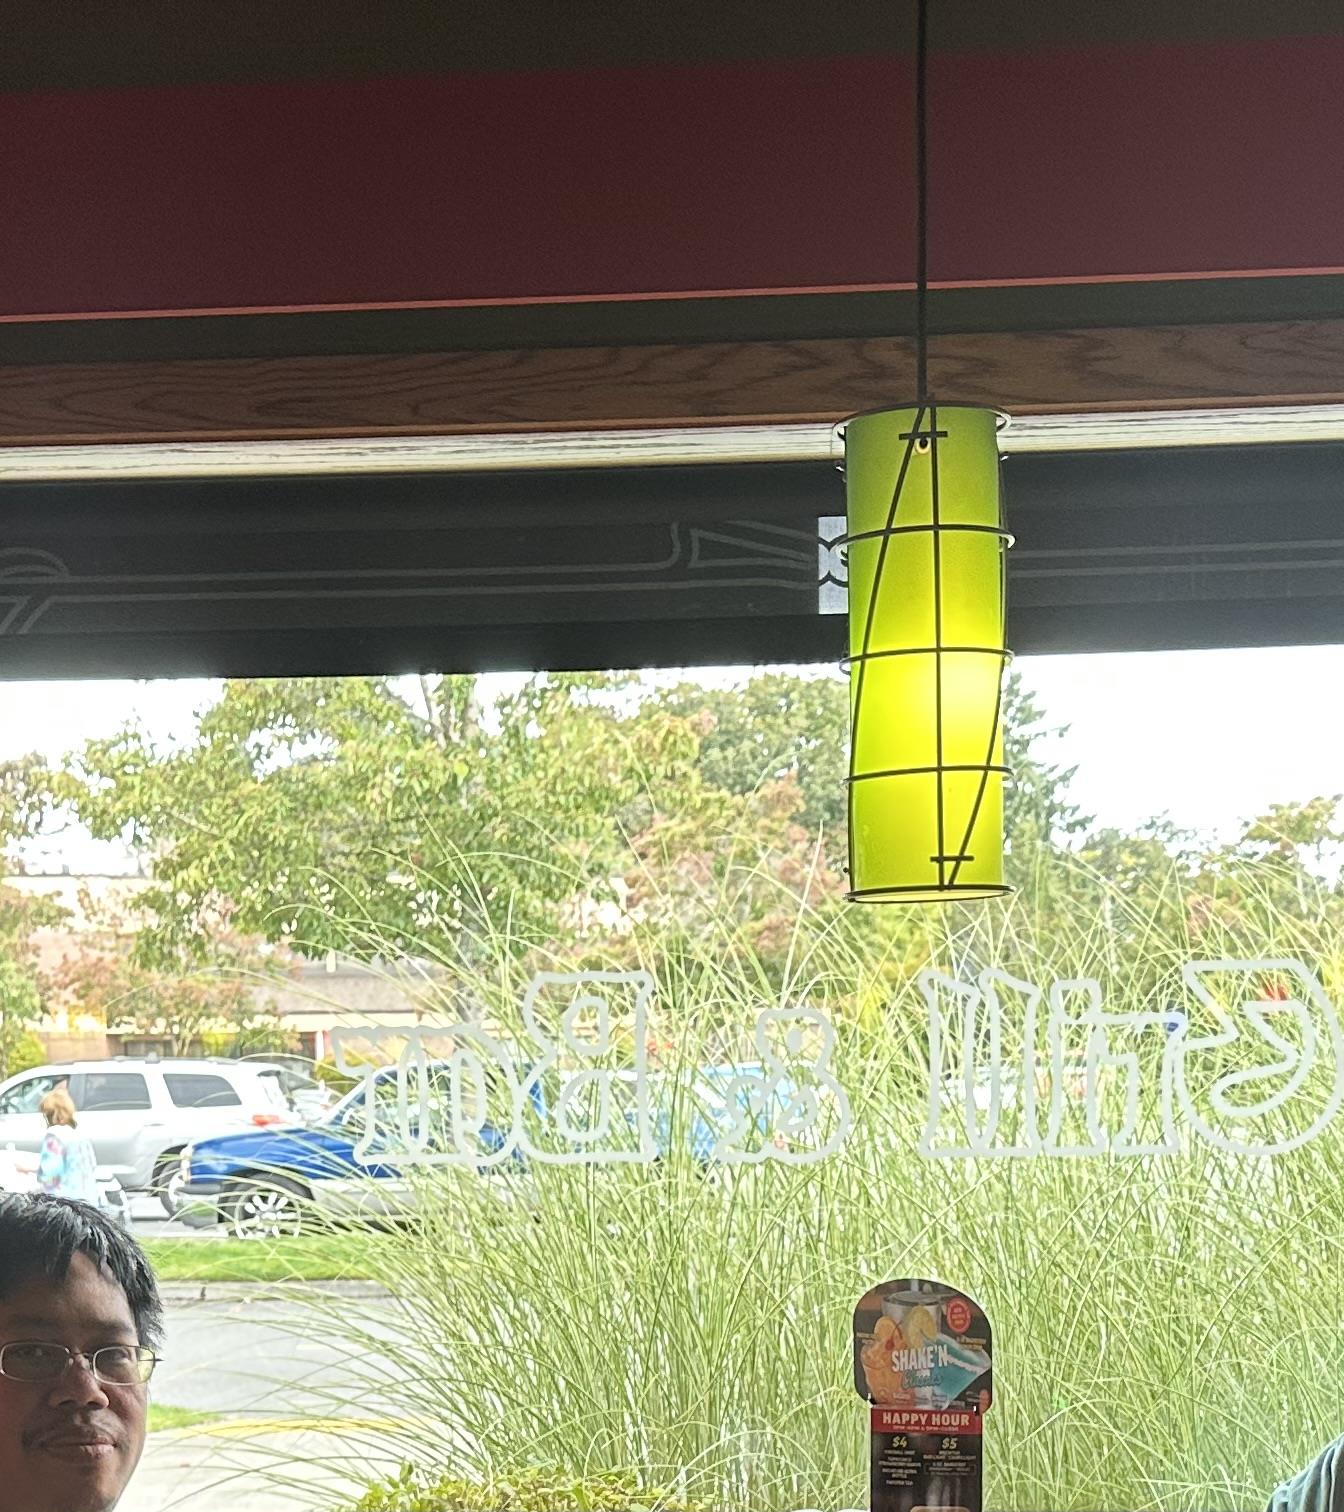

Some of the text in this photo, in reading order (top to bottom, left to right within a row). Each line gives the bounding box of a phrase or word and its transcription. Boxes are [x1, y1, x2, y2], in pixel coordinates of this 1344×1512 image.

[882, 1412, 970, 1426] HAPPY HOUR
[892, 1436, 908, 1448] $4
[942, 1437, 958, 1450] $5
